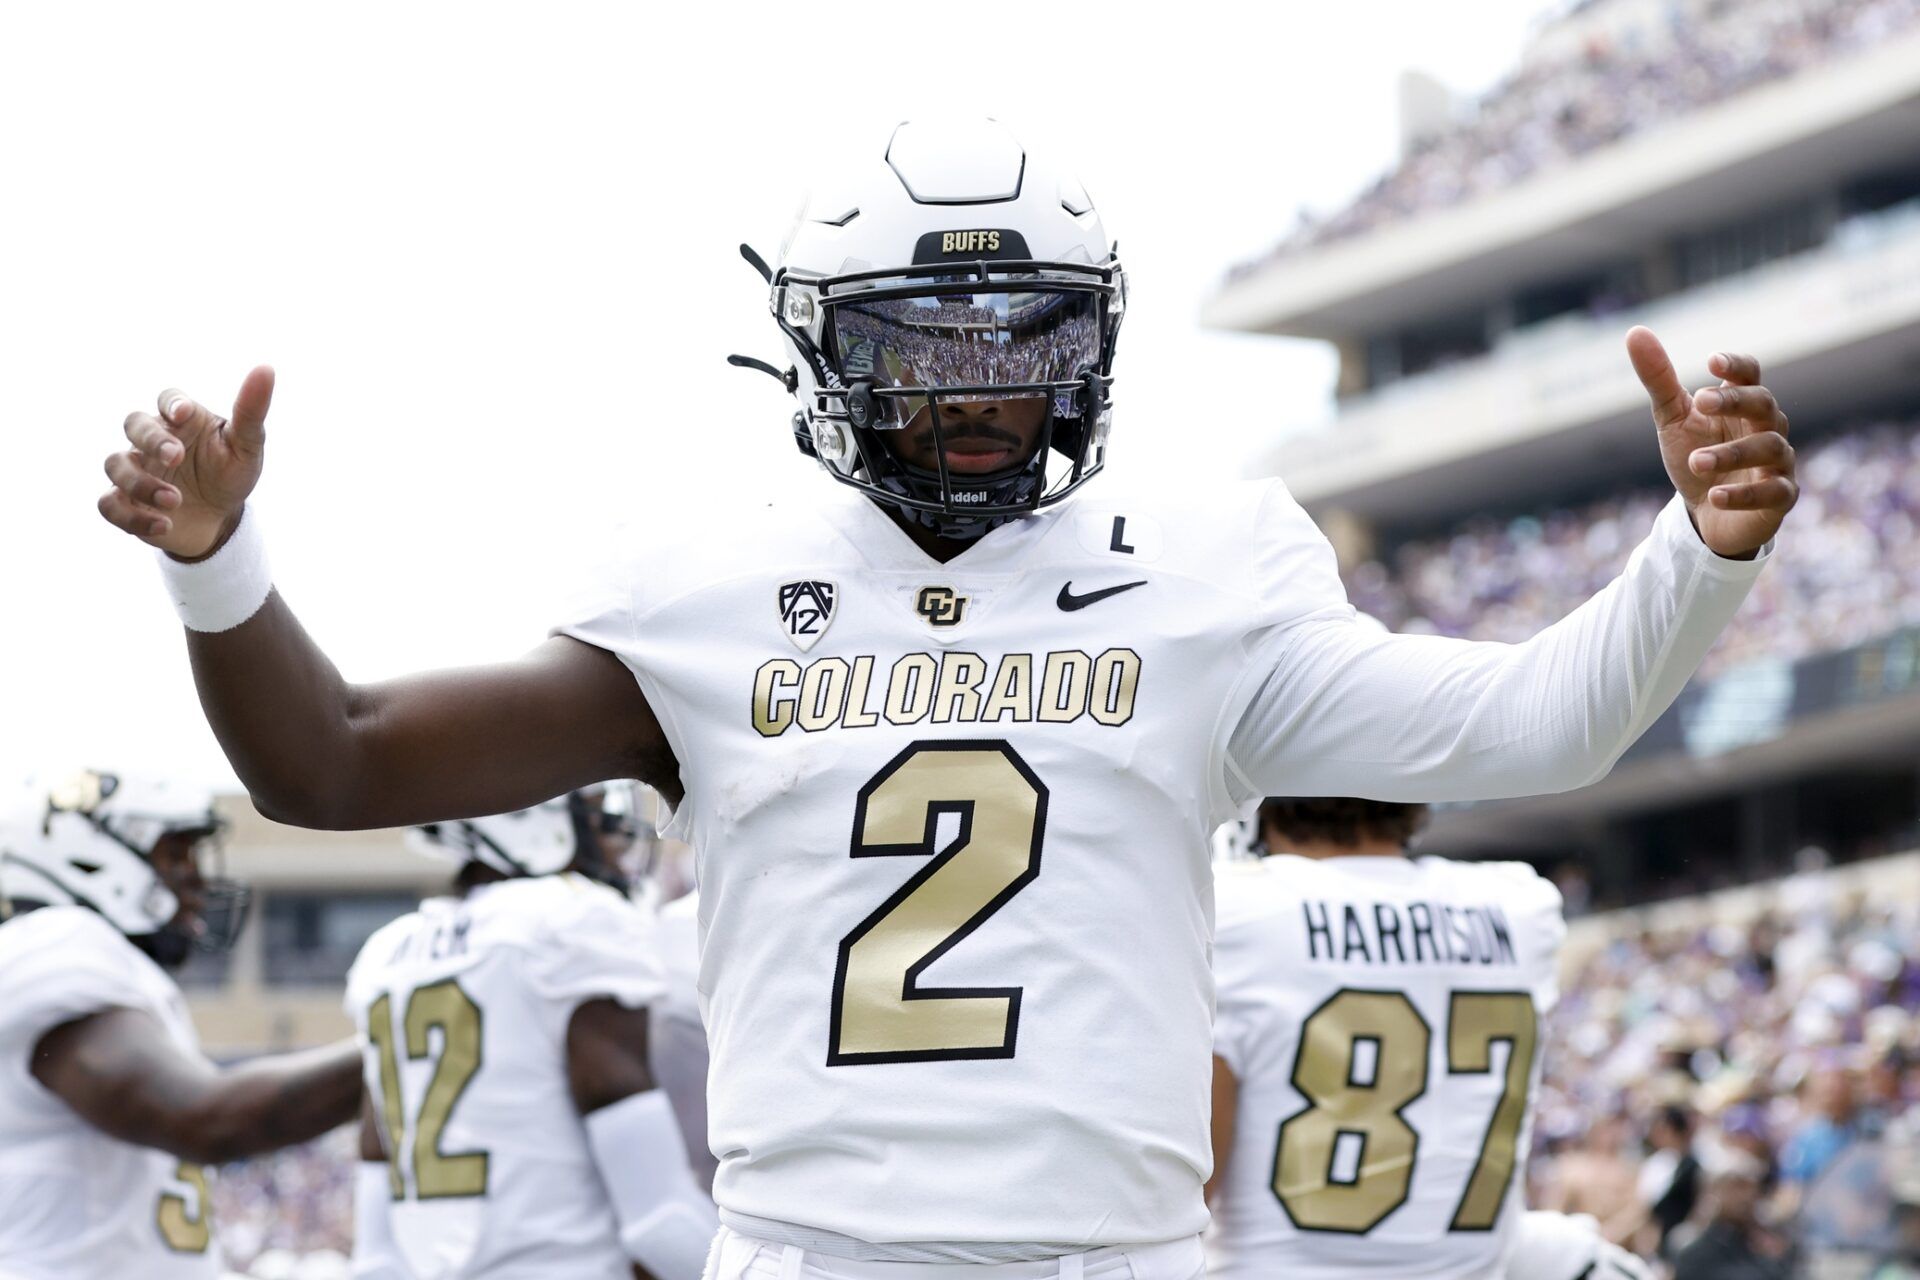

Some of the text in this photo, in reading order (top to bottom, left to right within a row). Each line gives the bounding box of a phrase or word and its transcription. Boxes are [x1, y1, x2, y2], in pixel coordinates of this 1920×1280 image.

[942, 231, 1000, 253] BUFFS
[1110, 516, 1134, 554] L
[778, 580, 833, 623] PAC
[791, 608, 820, 635] 12
[751, 648, 1142, 738] COLORADO
[826, 739, 1050, 1067] 2
[1303, 901, 1517, 964] HARRISON
[368, 976, 489, 1201] 12
[1271, 987, 1537, 1237] 87
